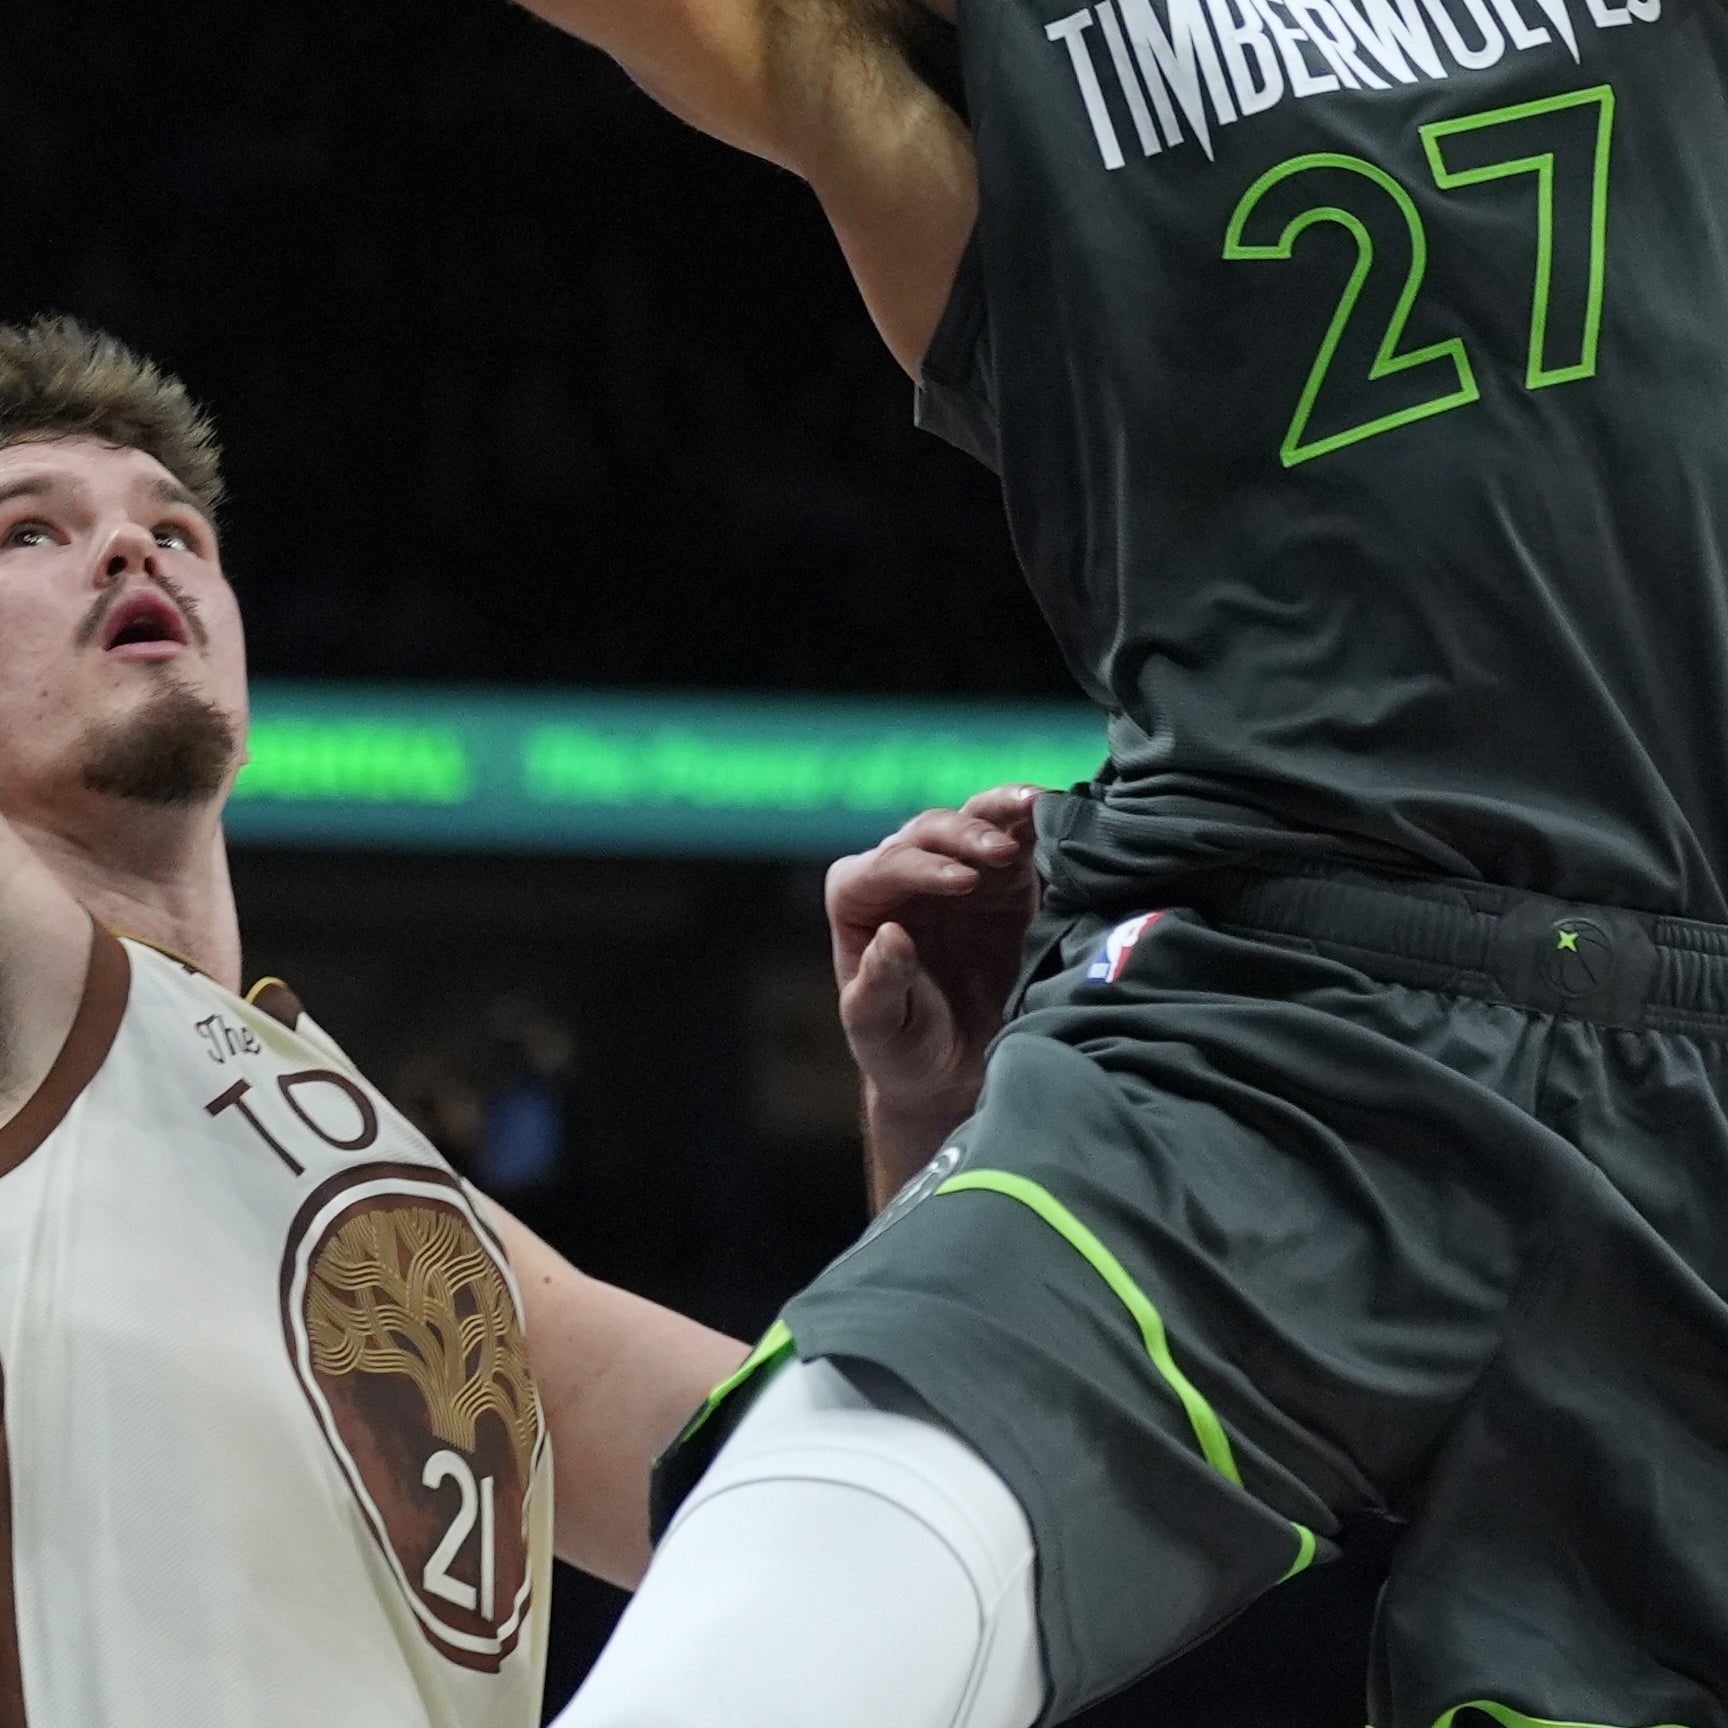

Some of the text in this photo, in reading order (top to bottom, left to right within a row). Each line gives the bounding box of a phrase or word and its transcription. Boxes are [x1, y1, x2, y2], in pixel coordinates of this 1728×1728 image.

[1223, 84, 1615, 468] 27
[195, 1015, 262, 1065] The
[205, 1069, 379, 1178] TO
[423, 1449, 495, 1622] 21
